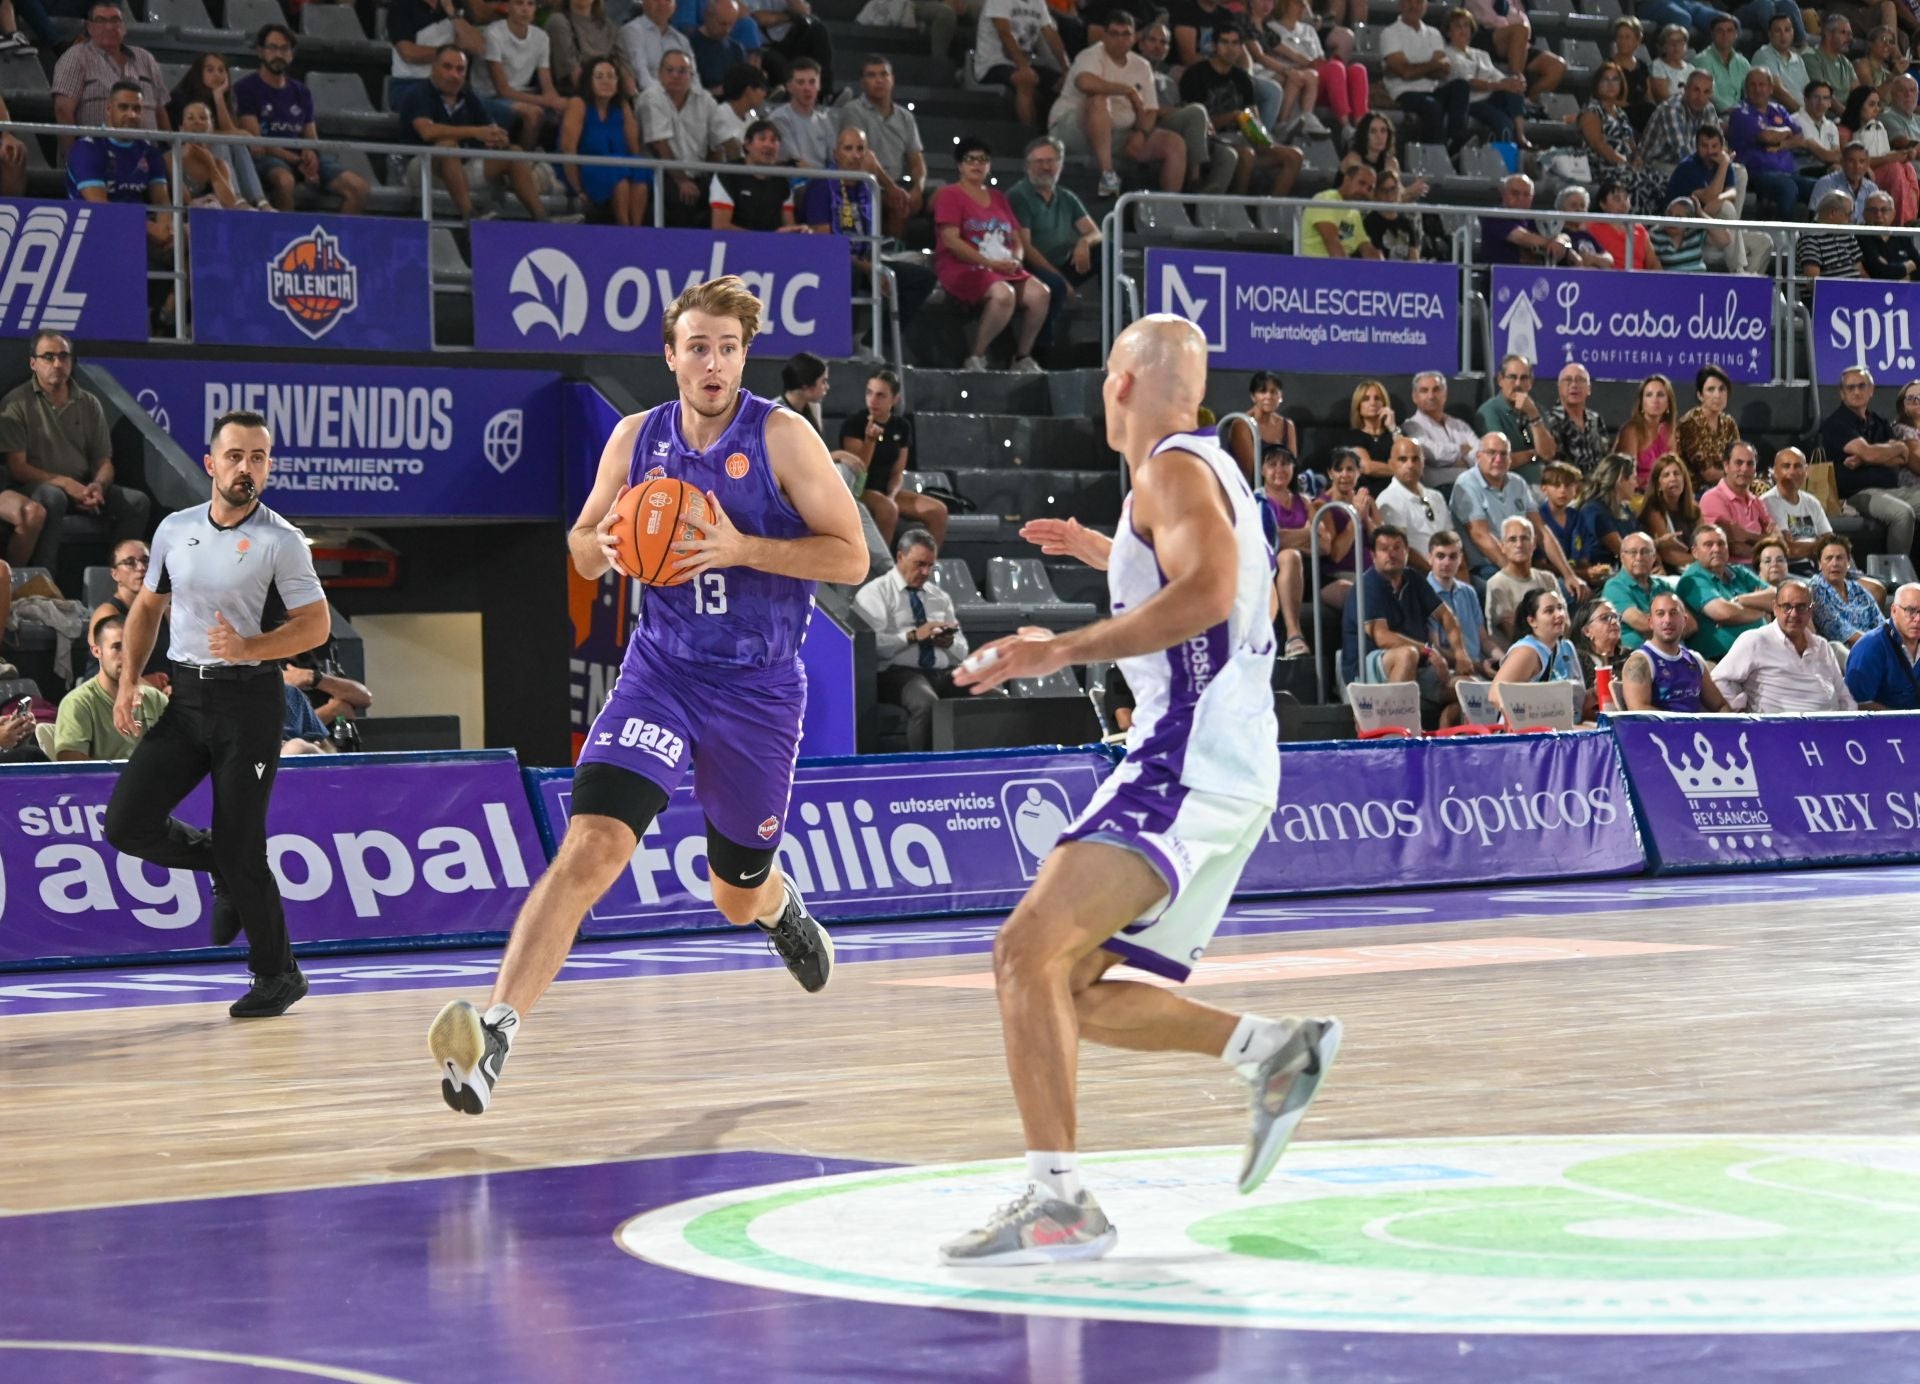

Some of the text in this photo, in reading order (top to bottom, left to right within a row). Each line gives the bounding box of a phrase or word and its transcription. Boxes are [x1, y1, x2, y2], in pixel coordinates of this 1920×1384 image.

[273, 271, 352, 300] PALENCIA
[1235, 285, 1444, 319] MORALESCERVERA
[1555, 281, 1767, 341] La casa dulce
[1330, 325, 1369, 343] Dental
[1371, 327, 1427, 345] Inmediata
[1581, 348, 1744, 367] CONFITERIA y CATERING
[692, 573, 727, 615] 13
[618, 717, 684, 763] gaza
[889, 793, 996, 814] autoservicios
[1440, 785, 1616, 848] ópticos
[1688, 798, 1764, 810] Hotel
[1692, 809, 1769, 826] REY SANCHO
[1794, 792, 1878, 834] REY
[946, 811, 1001, 833] ahorro
[35, 803, 530, 930] agopal
